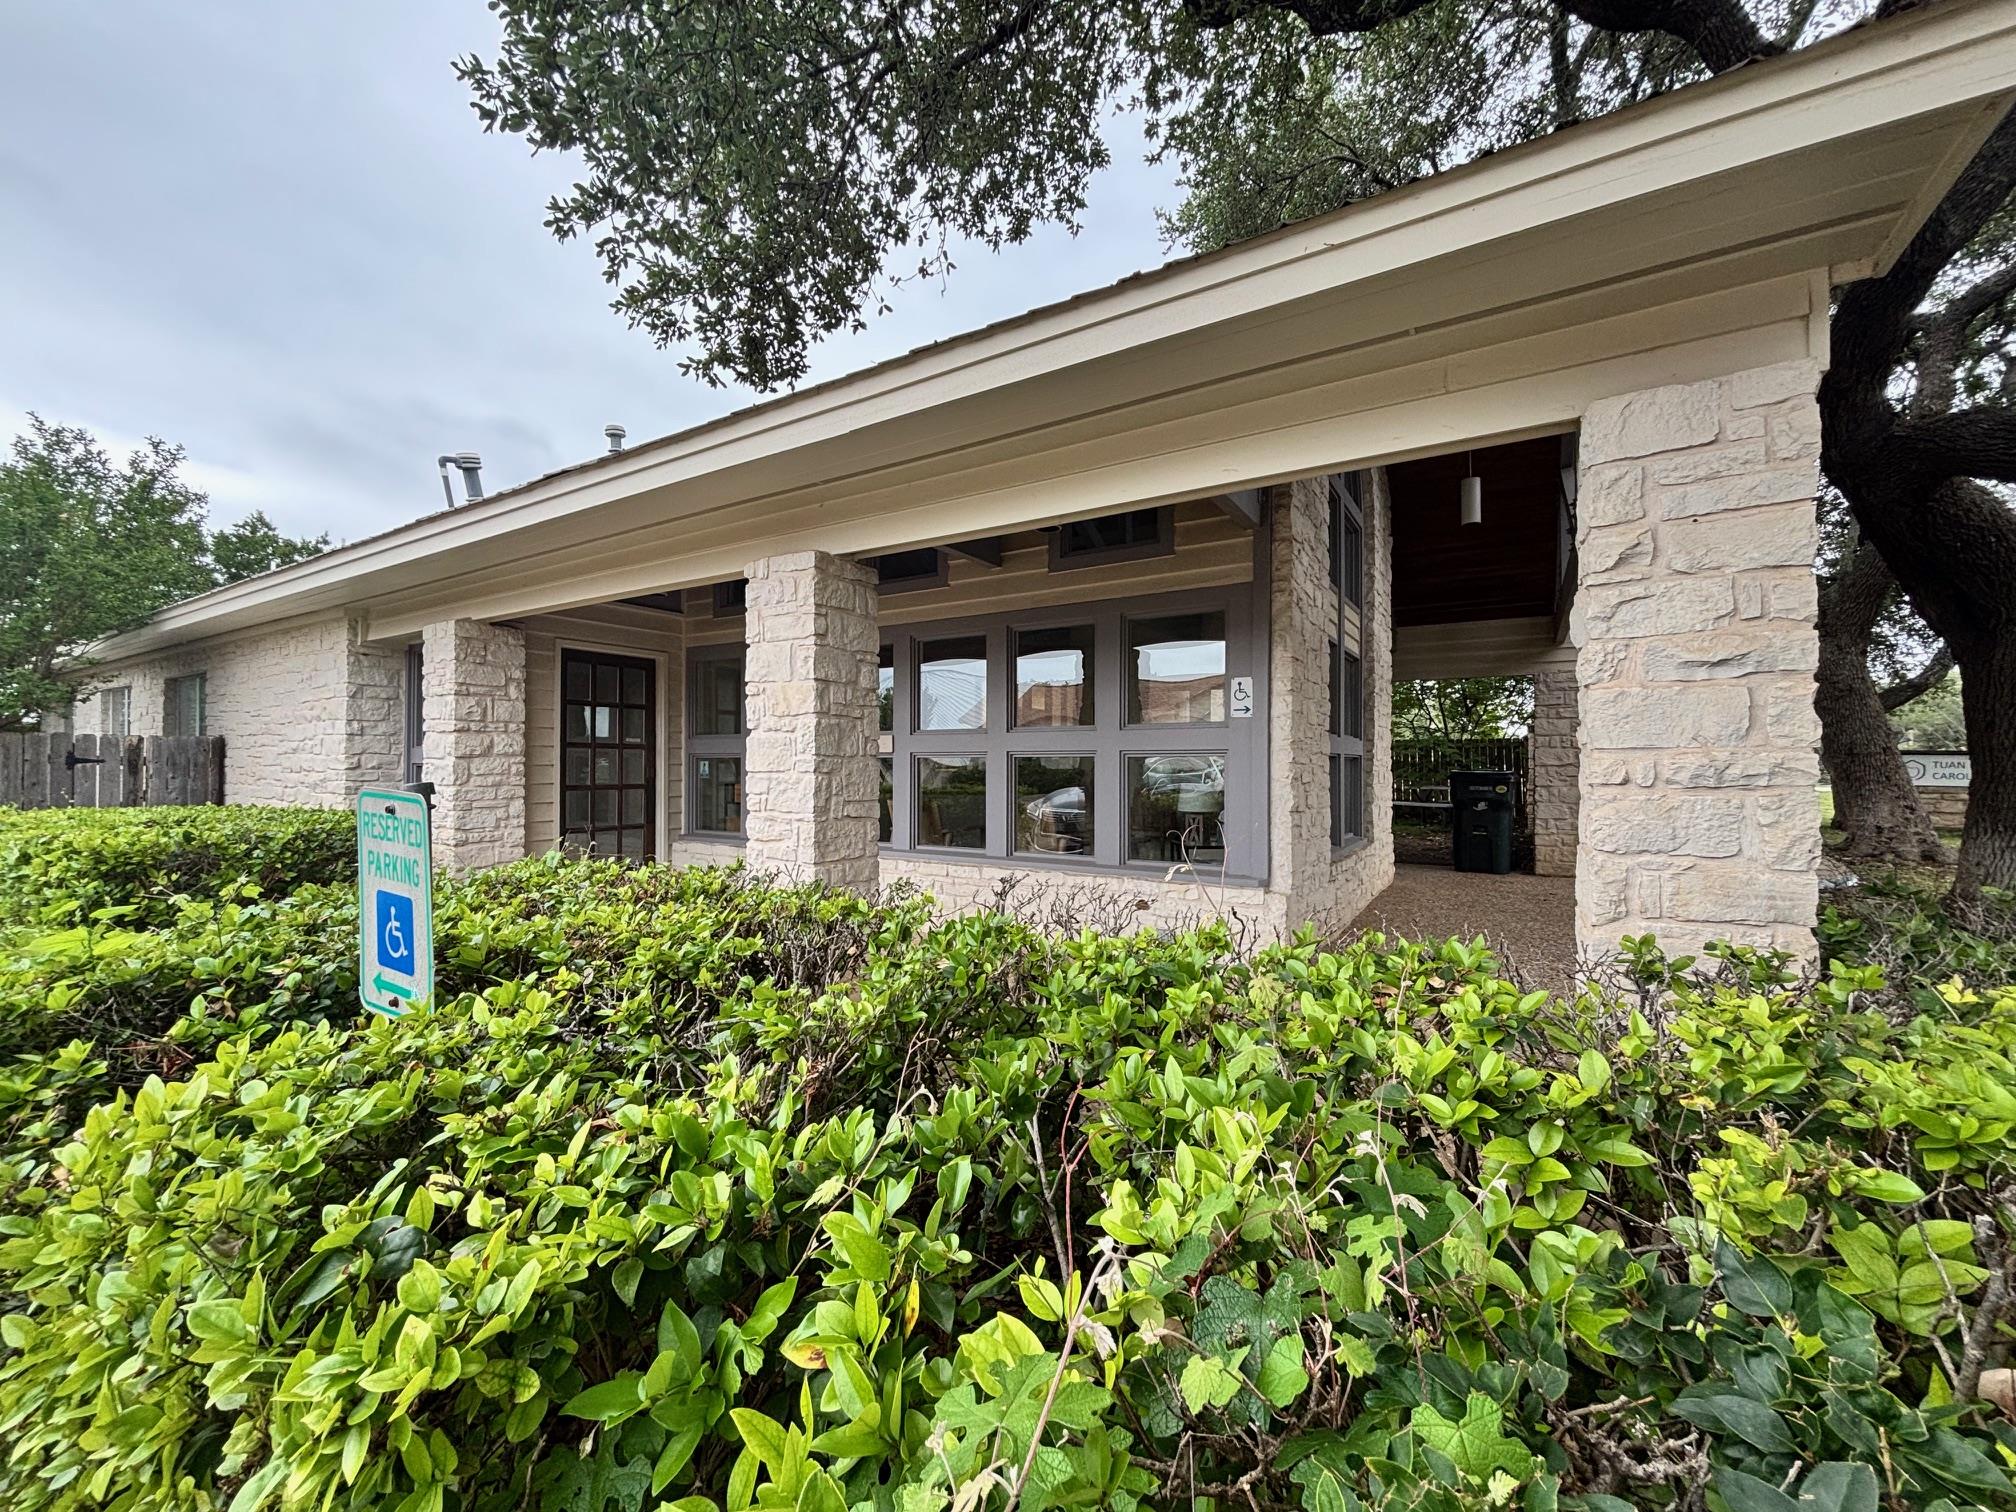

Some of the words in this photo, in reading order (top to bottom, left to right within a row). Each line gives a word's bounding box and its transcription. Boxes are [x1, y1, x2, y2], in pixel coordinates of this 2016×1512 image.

[1932, 761, 1965, 769] TUAN
[363, 812, 422, 848] RESERVED
[368, 850, 420, 888] PARKING
